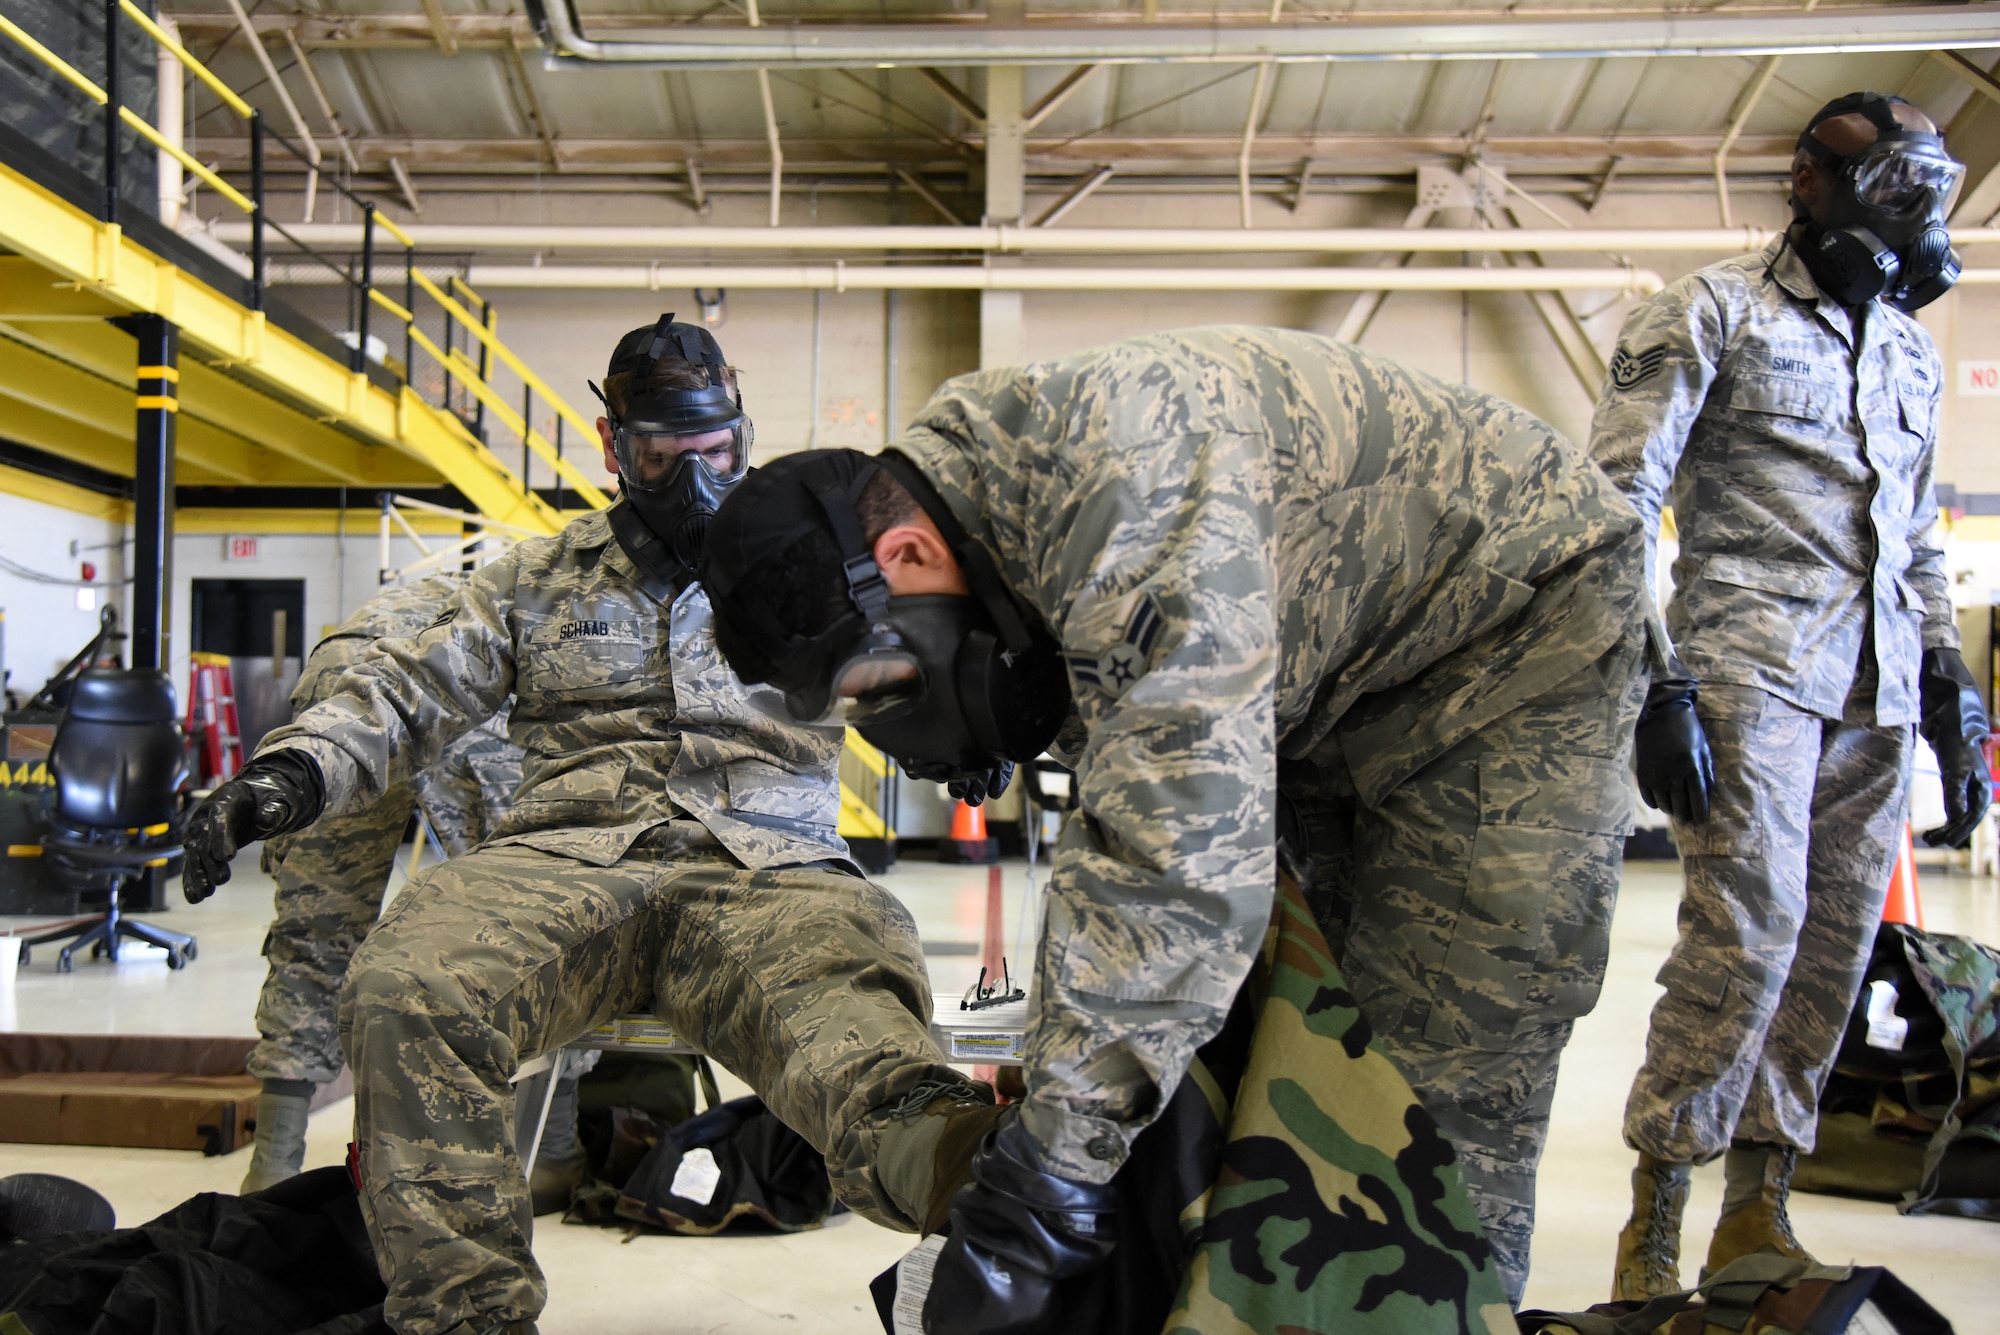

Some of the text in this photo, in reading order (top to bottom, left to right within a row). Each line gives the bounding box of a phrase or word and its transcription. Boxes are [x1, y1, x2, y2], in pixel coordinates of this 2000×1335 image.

[1772, 356, 1811, 376] SMITH
[1970, 367, 1999, 389] NO
[233, 538, 257, 558] EXIT
[559, 620, 608, 639] SCHAAB
